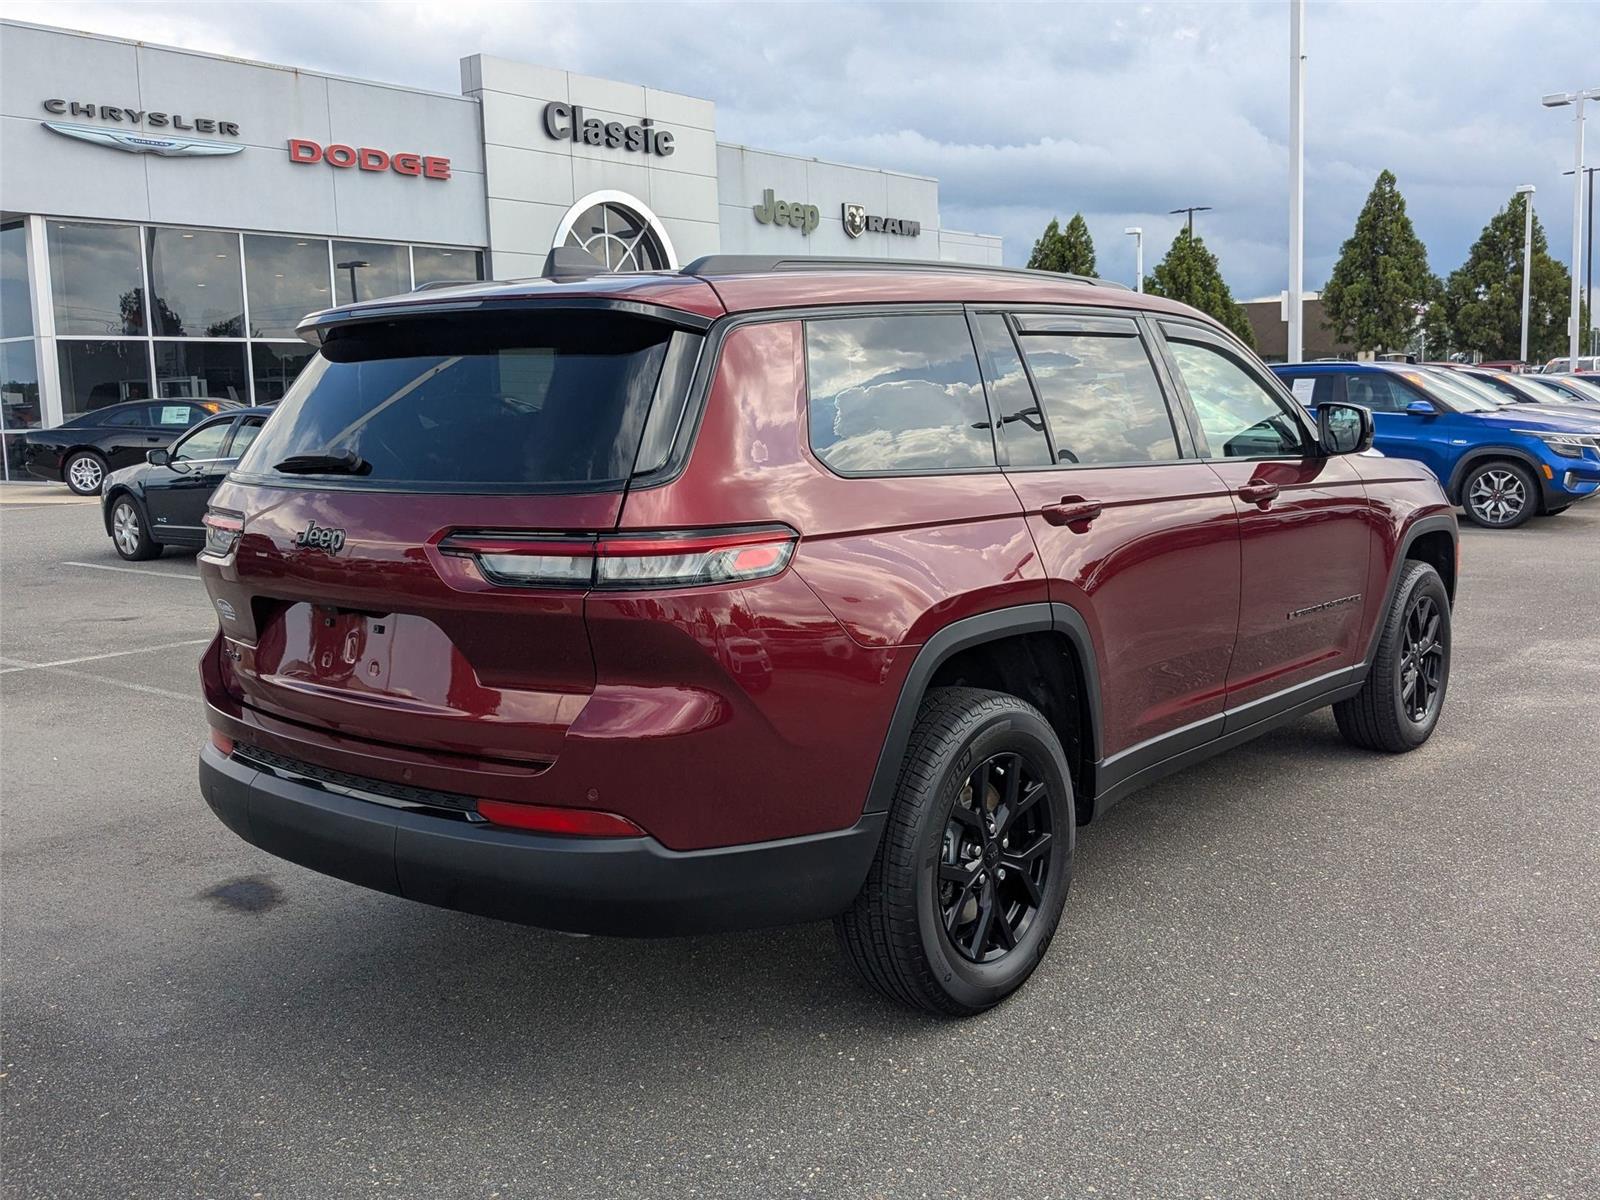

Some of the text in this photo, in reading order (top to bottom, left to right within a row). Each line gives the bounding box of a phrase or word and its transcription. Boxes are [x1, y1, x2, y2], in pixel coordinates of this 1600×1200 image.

[43, 98, 241, 137] CHRYSLER
[543, 101, 675, 156] Classic
[288, 138, 451, 180] DODGE
[753, 188, 820, 236] Jeep
[865, 214, 921, 237] RAM
[295, 519, 347, 557] Jeep
